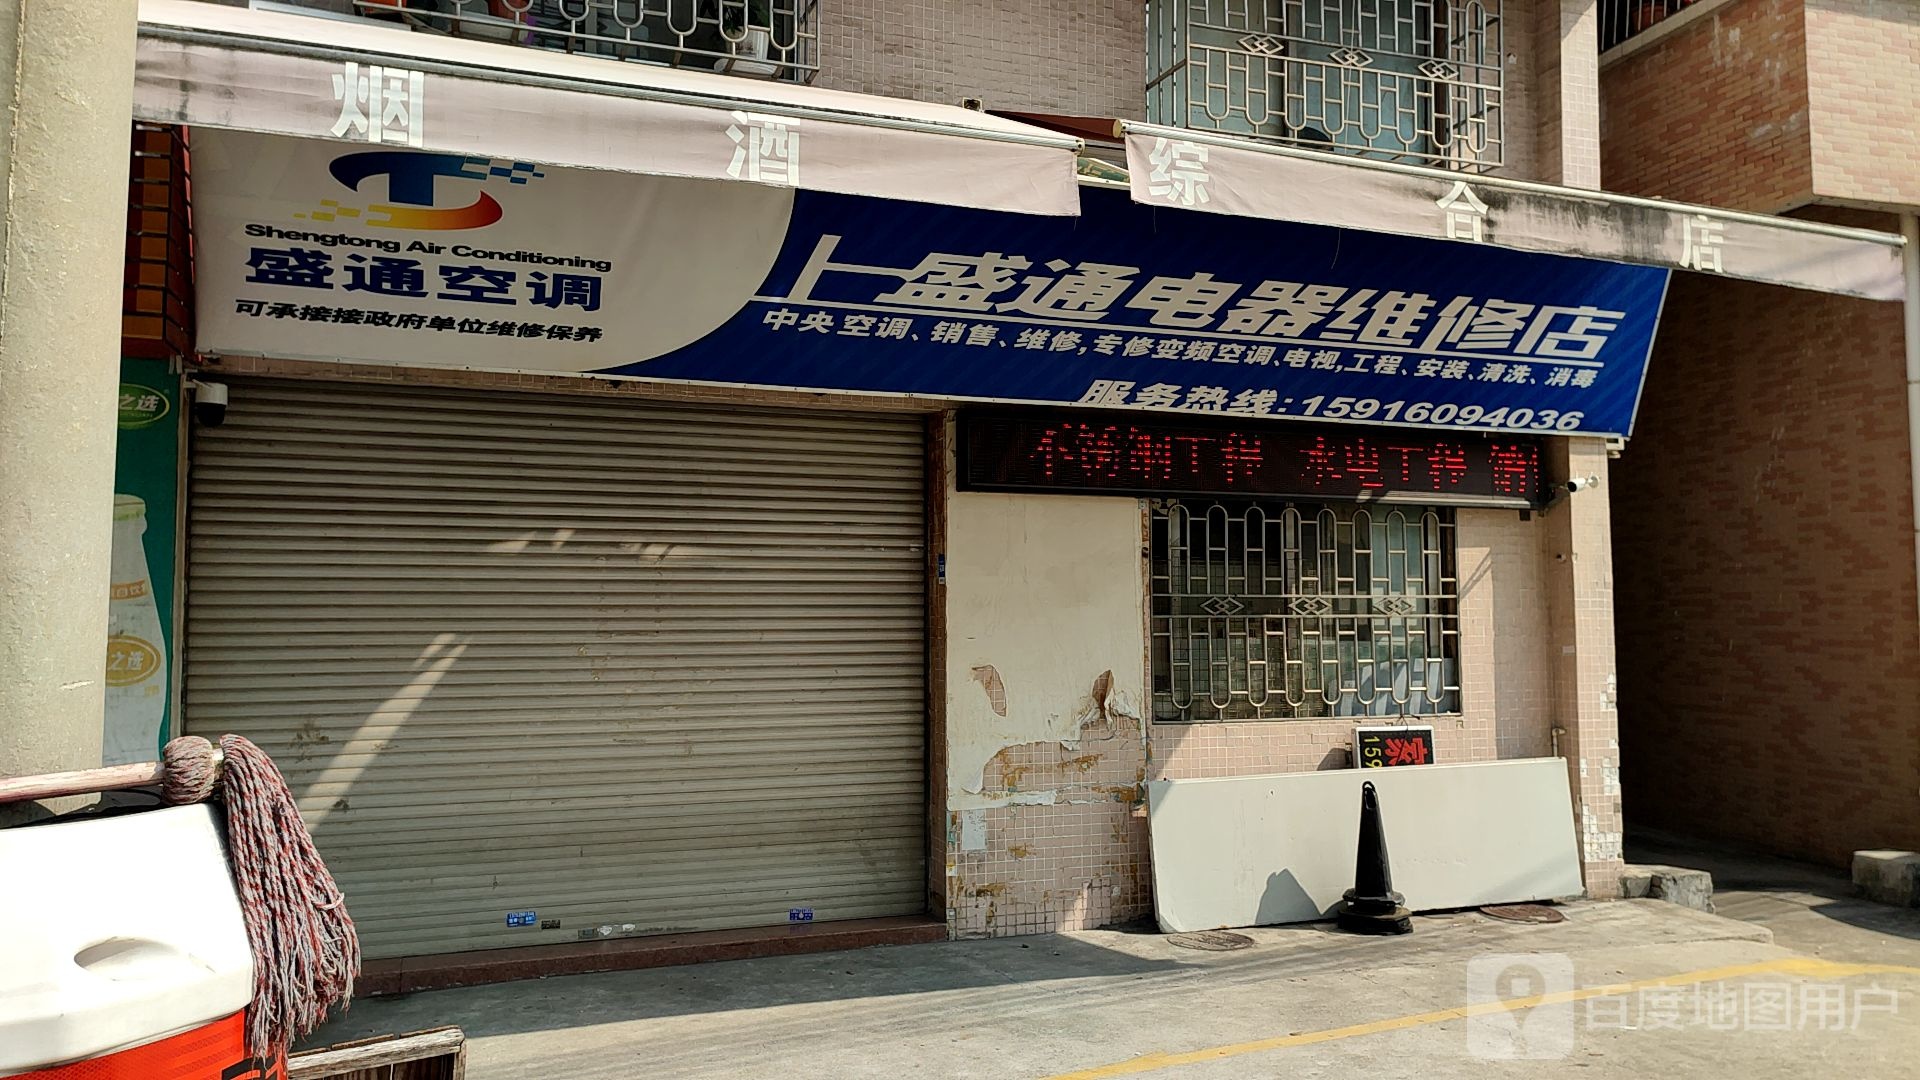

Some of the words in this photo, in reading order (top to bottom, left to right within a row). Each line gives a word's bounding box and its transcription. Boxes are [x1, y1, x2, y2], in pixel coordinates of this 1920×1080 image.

[245, 223, 400, 253] Shengtong
[406, 239, 447, 256] Air
[451, 244, 612, 273] Conditioning
[245, 246, 603, 312] 盛通空调
[235, 299, 603, 343] 可承接接政府单位维修保养
[1385, 737, 1429, 766] 家
